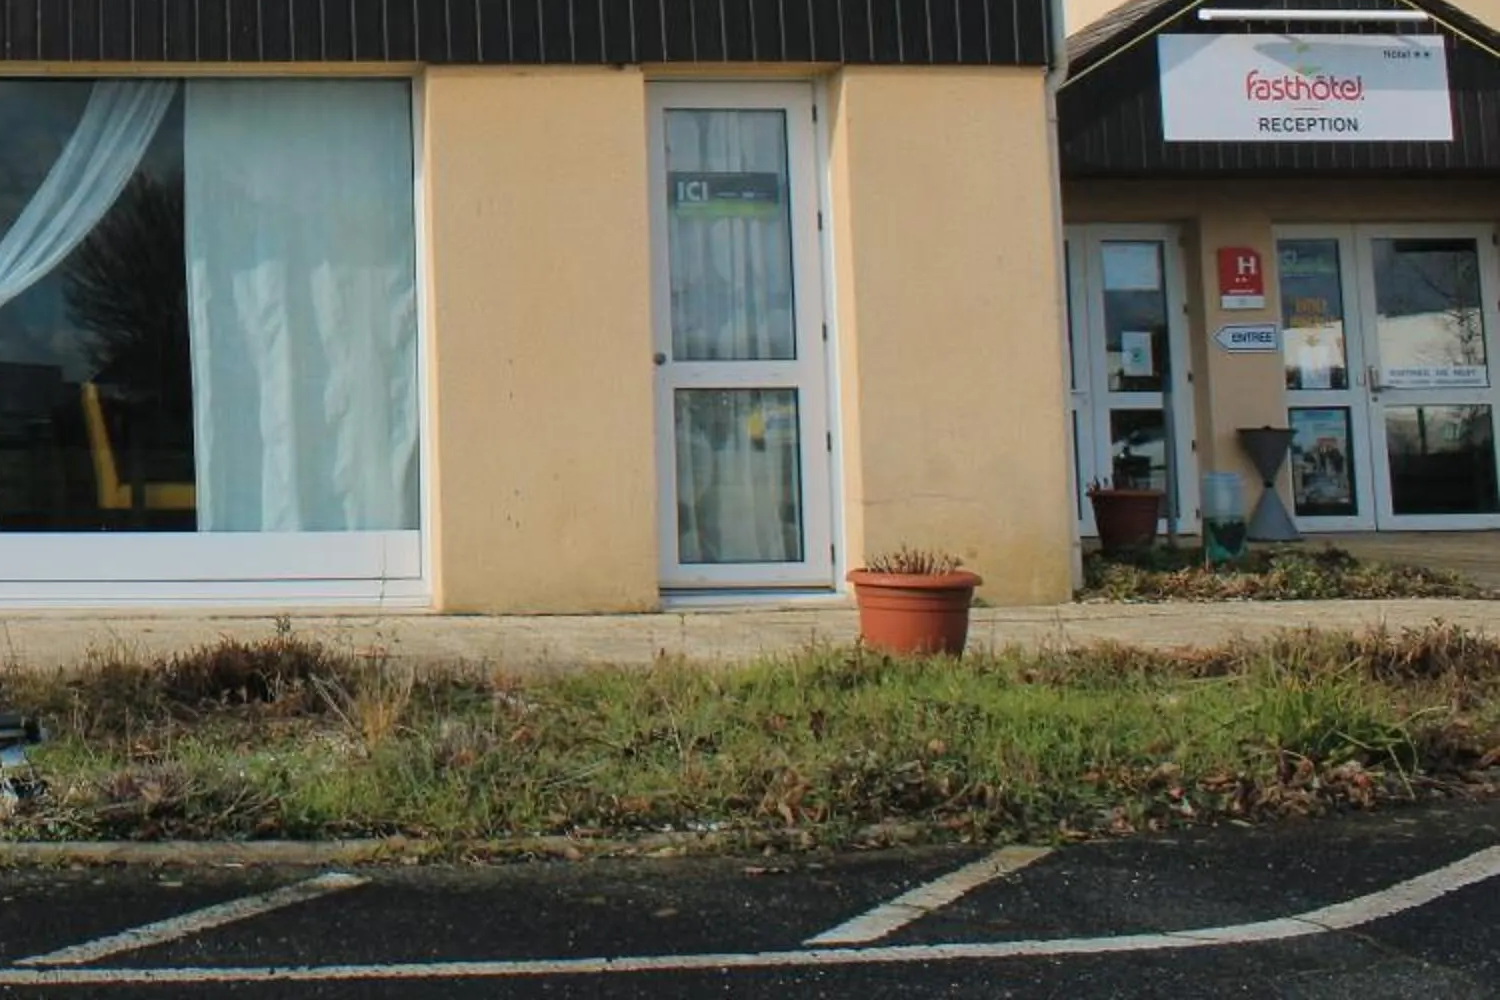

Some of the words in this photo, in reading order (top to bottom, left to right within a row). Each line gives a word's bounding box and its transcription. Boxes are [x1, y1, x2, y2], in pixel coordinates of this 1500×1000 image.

[1259, 117, 1359, 133] RECEPTION
[677, 181, 708, 201] ICI
[1237, 256, 1257, 274] H
